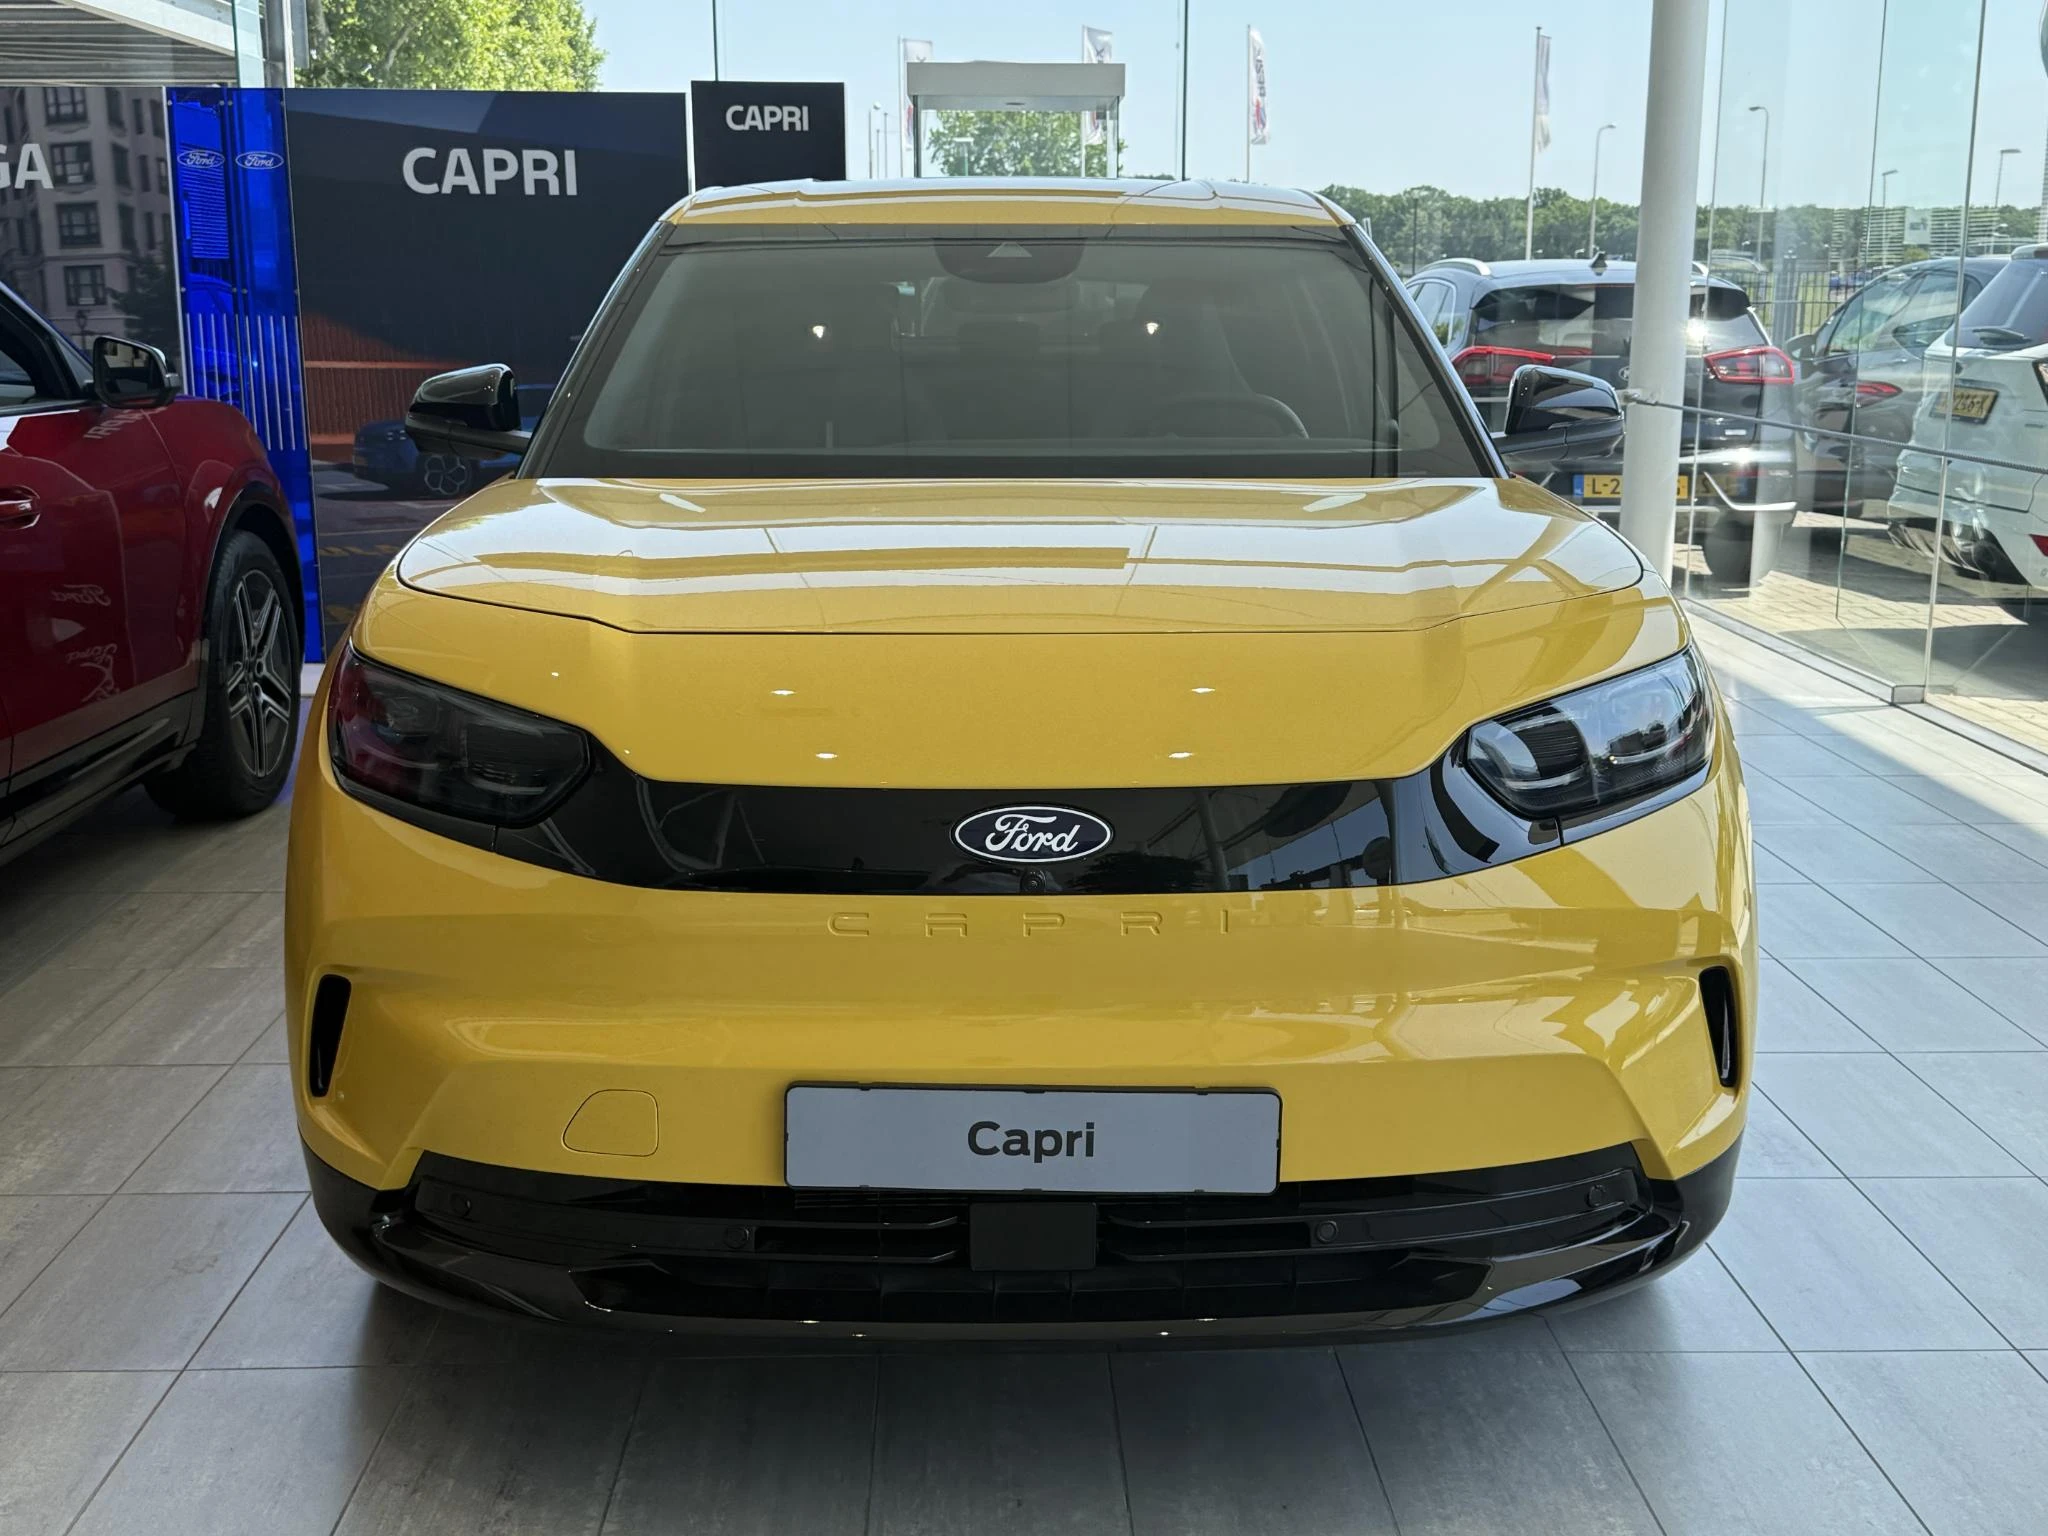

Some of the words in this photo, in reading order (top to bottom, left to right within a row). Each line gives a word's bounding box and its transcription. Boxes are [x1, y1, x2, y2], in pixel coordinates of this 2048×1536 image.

[725, 104, 809, 131] CAPRI
[186, 152, 216, 166] Ford
[244, 153, 274, 167] Ford
[402, 147, 578, 196] CAPRI
[985, 813, 1081, 852] Ford
[826, 908, 1229, 938] CAPRI
[967, 1120, 1095, 1164] Capri
